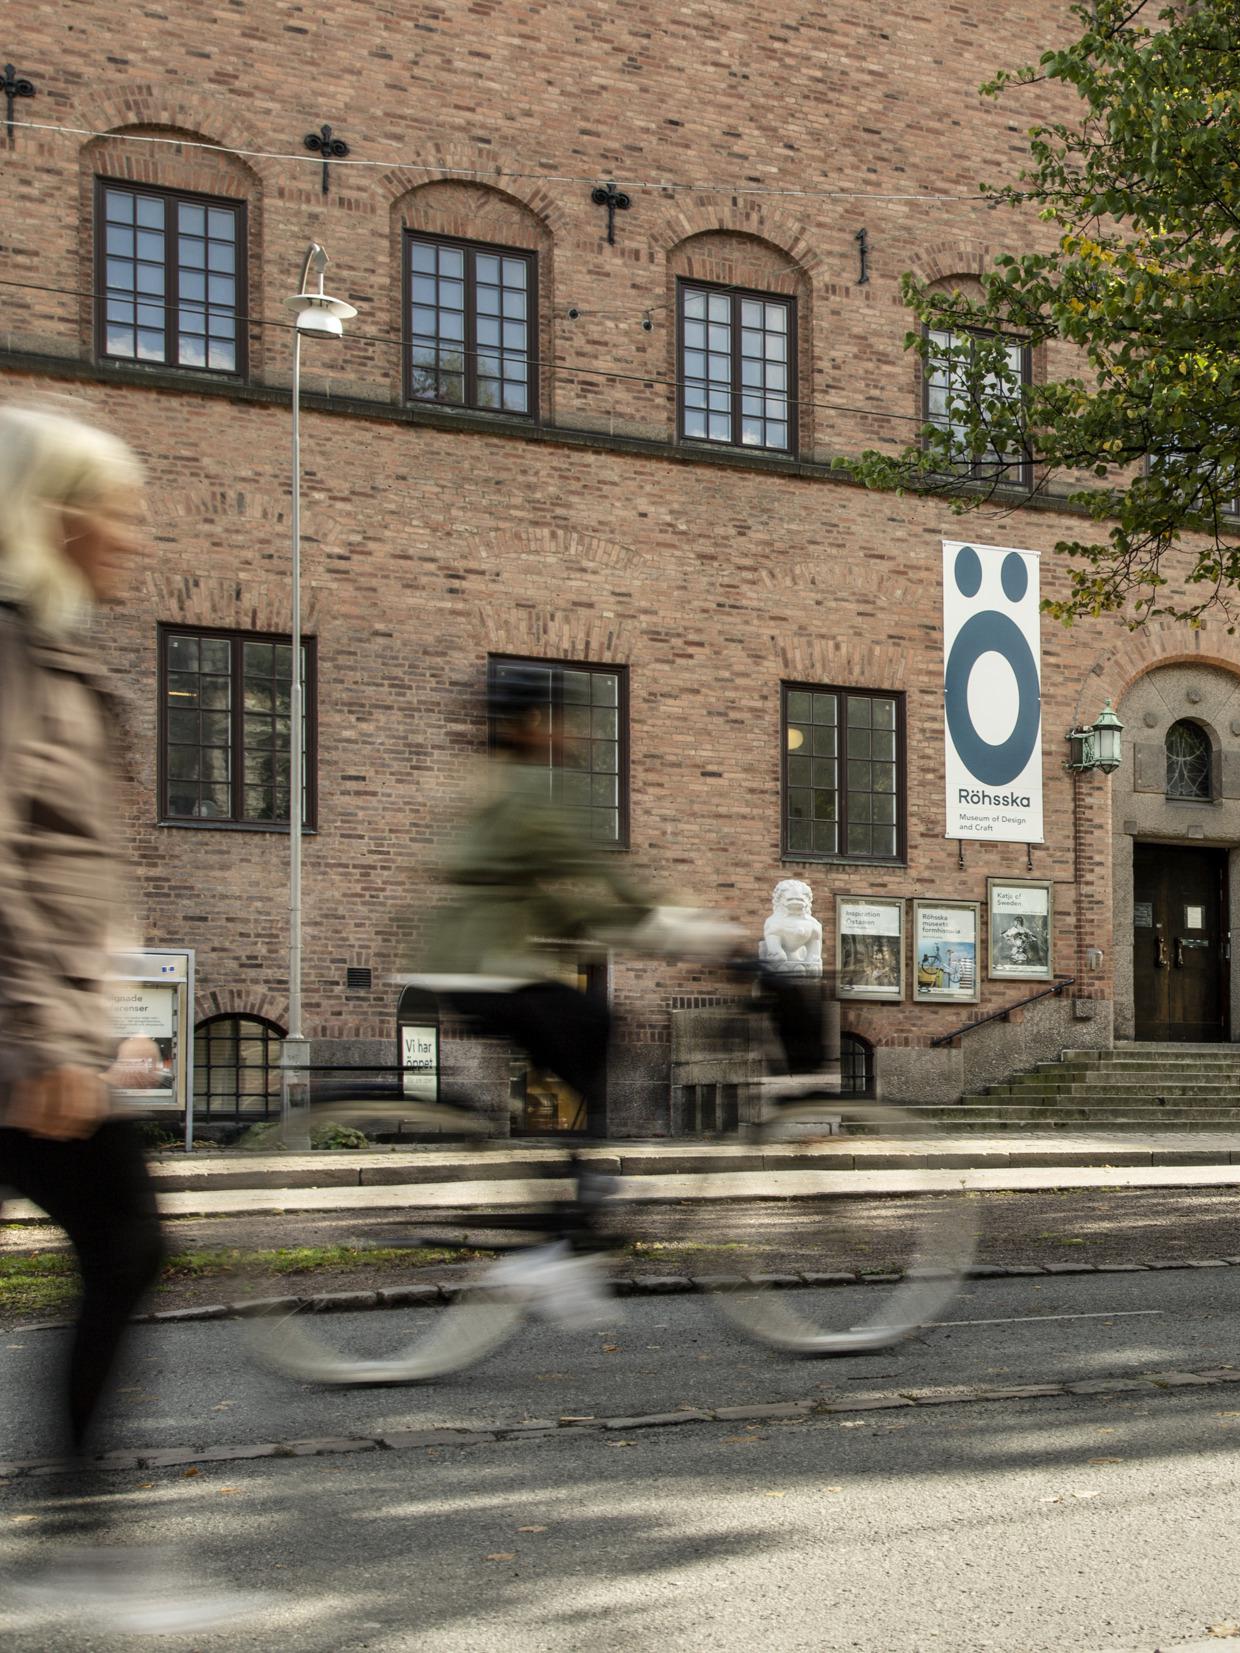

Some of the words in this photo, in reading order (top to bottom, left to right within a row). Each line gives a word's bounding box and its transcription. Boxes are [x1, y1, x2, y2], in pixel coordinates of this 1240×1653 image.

[958, 788, 1031, 808] Röhsska
[959, 813, 990, 822] Museum
[1001, 816, 1026, 825] Design
[959, 823, 973, 831] and
[974, 823, 993, 832] Craft
[997, 899, 1022, 907] Sweden
[922, 913, 948, 921] Röhsska
[405, 1039, 415, 1053] Vi
[418, 1039, 432, 1054] har
